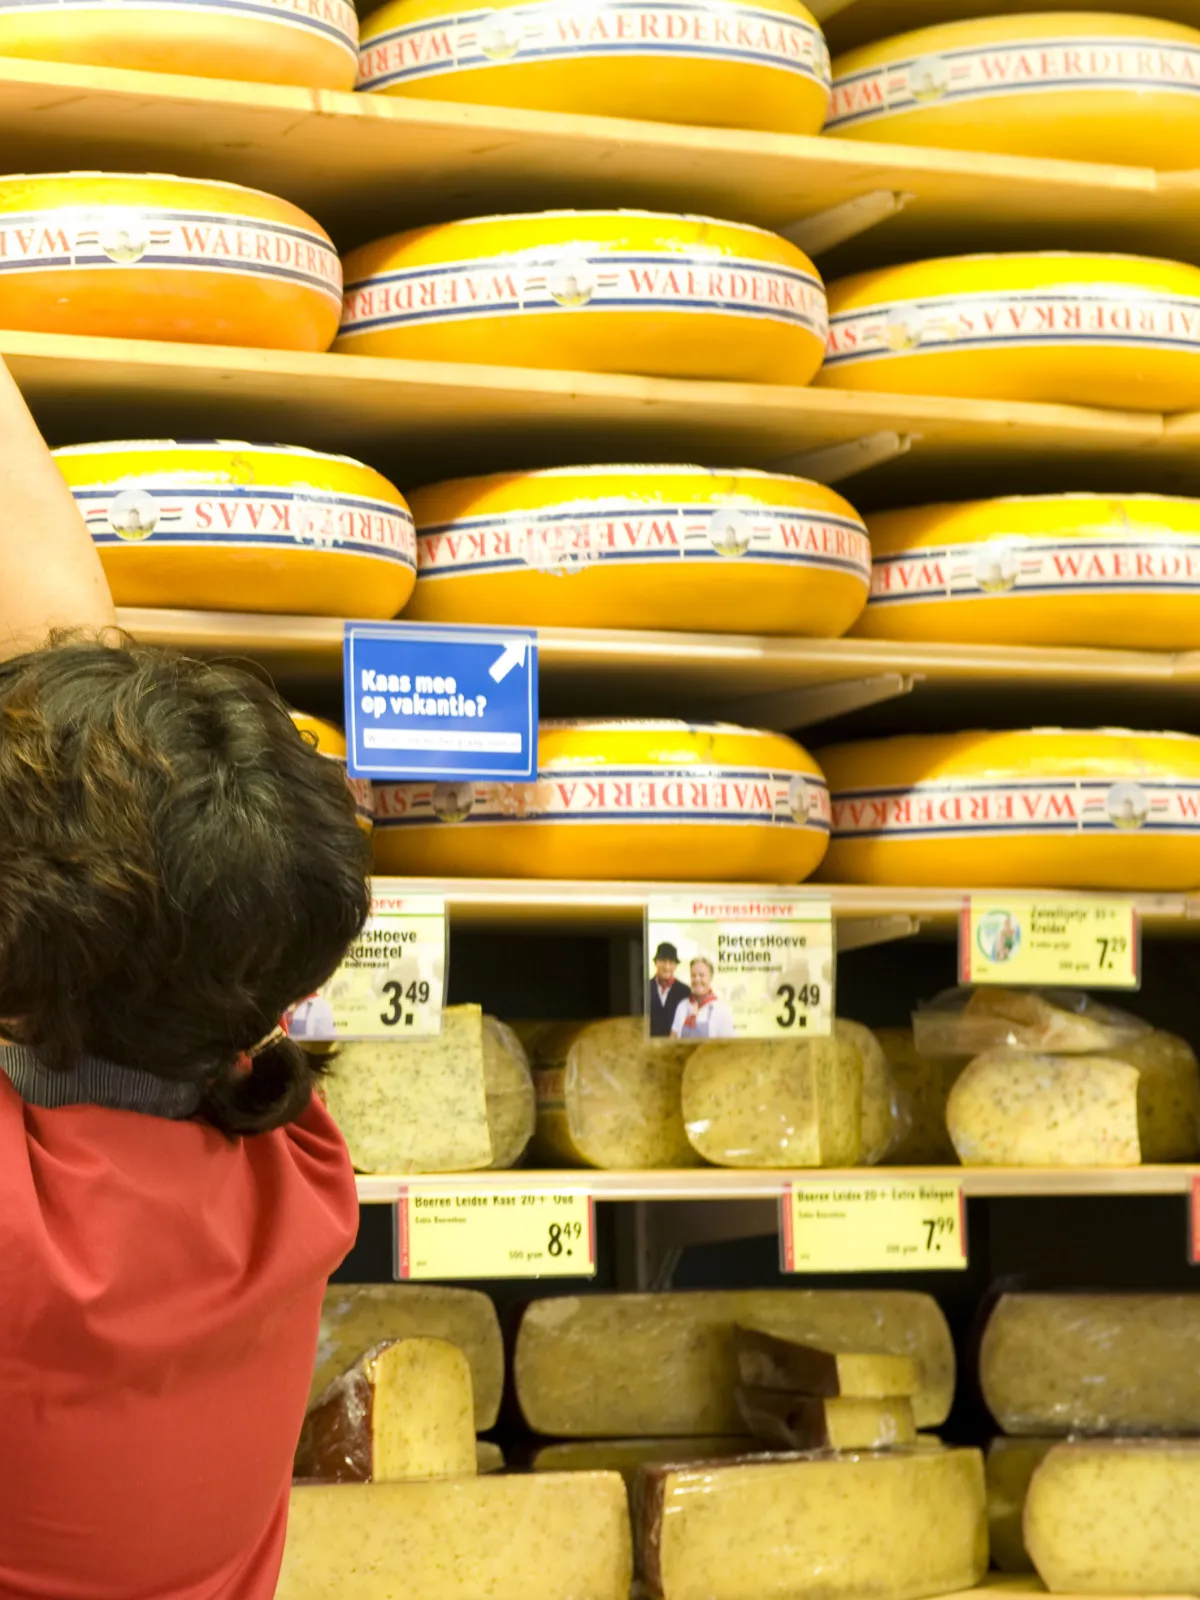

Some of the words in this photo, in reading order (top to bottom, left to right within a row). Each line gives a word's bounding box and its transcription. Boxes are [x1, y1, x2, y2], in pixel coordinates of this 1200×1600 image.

[556, 14, 801, 57] WAERDERKAAS
[980, 49, 1200, 80] WAERDERKA
[958, 304, 1200, 336] AERDERKAAS
[361, 669, 411, 692] Kaas
[415, 675, 457, 694] mee
[361, 695, 387, 719] op
[390, 692, 487, 718] vakantie?
[718, 951, 771, 962] Kruiden
[380, 980, 430, 1026] 3.49
[776, 984, 820, 1028] 3.49
[548, 1222, 582, 1257] 8.49
